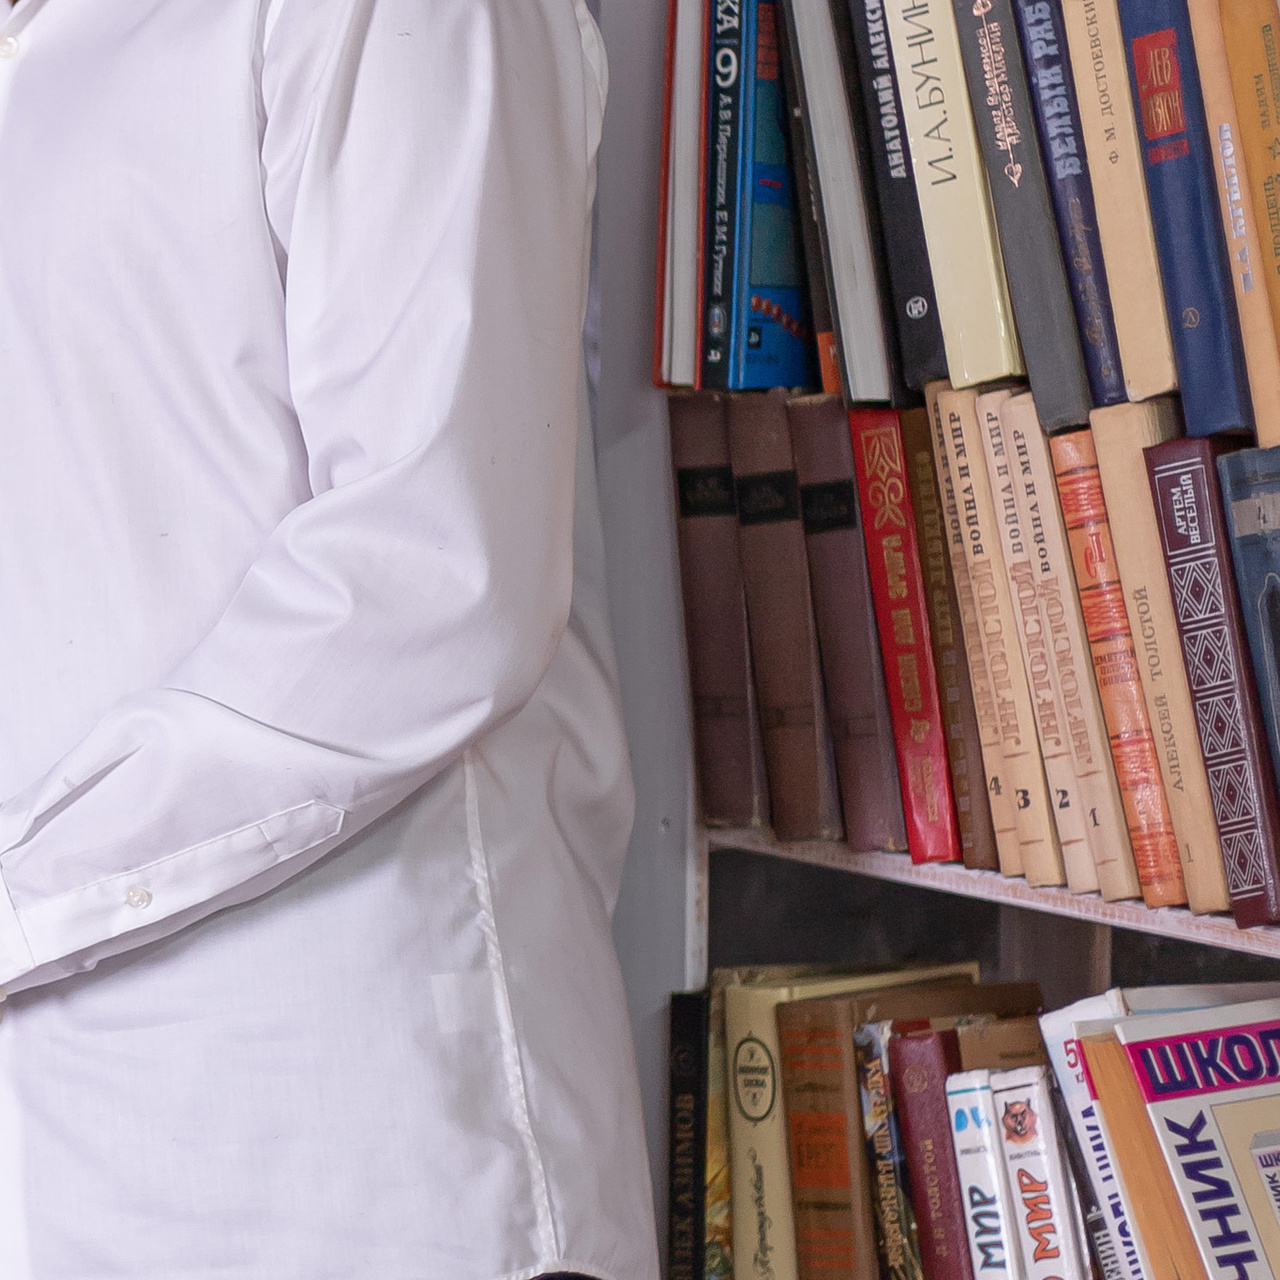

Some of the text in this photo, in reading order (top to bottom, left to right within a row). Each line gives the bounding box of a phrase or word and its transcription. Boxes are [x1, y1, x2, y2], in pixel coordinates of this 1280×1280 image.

[715, 47, 739, 89] 9
[1024, 0, 1083, 179] БЕЛЫЙ РАБ
[873, 75, 907, 179] АНАТОЛИЙ
[948, 412, 985, 556] ВОЙНА И МИР
[985, 411, 1024, 554] ВОЙНА И МИР
[1013, 429, 1052, 574] ВОЙНА И МИР
[1169, 485, 1190, 536] АРТЕМ
[1179, 472, 1202, 545] ВЕСЕЛЫЙ
[1131, 585, 1185, 792] АЛЕКСЕЙ ТОЛСТОЙ
[988, 774, 1003, 797] 4
[1015, 786, 1031, 810] 3
[1056, 788, 1071, 810] 2
[1088, 807, 1100, 828] 1
[1063, 1038, 1080, 1069] 5
[967, 1184, 1009, 1271] МИР
[1016, 1167, 1061, 1264] МИР
